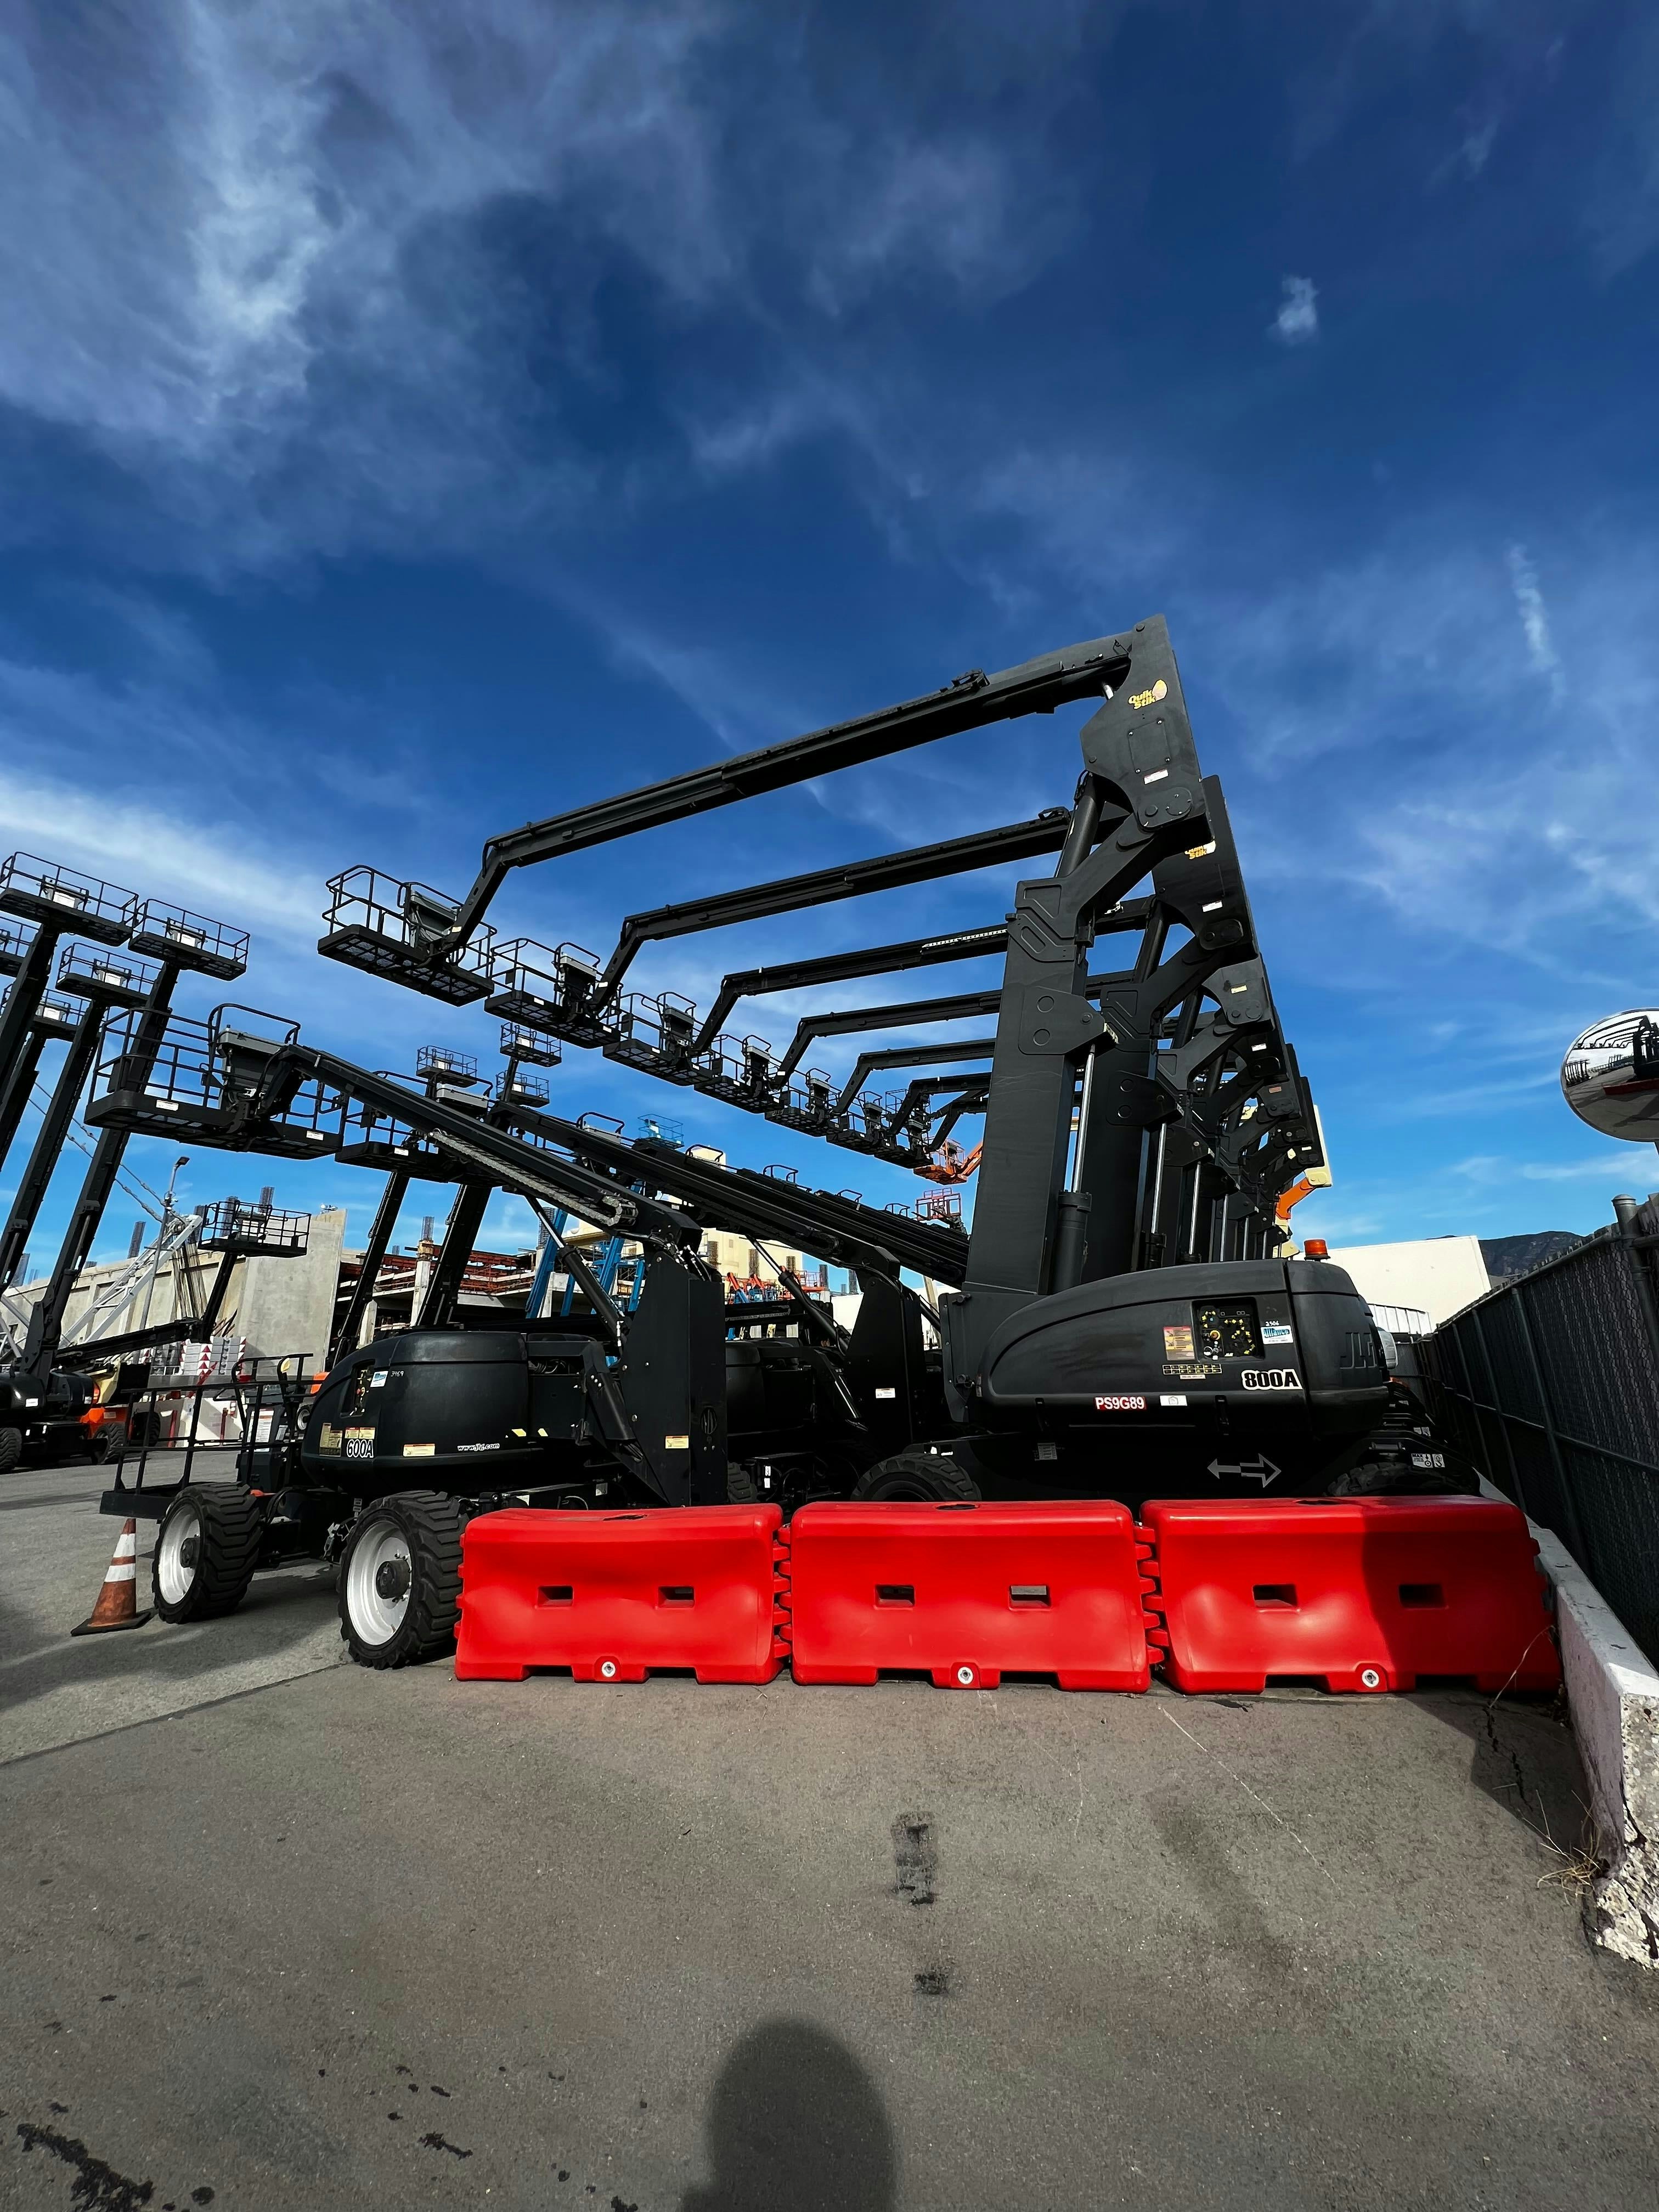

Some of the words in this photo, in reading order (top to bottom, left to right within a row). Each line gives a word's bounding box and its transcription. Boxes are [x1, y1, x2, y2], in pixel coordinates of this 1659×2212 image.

[1128, 690, 1152, 704] Quik
[1133, 696, 1156, 709] Stik
[1243, 1370, 1302, 1389] 800A
[1095, 1397, 1144, 1409] PS9G89
[347, 1439, 374, 1458] 600A
[457, 1443, 500, 1451] www.jlg.com
